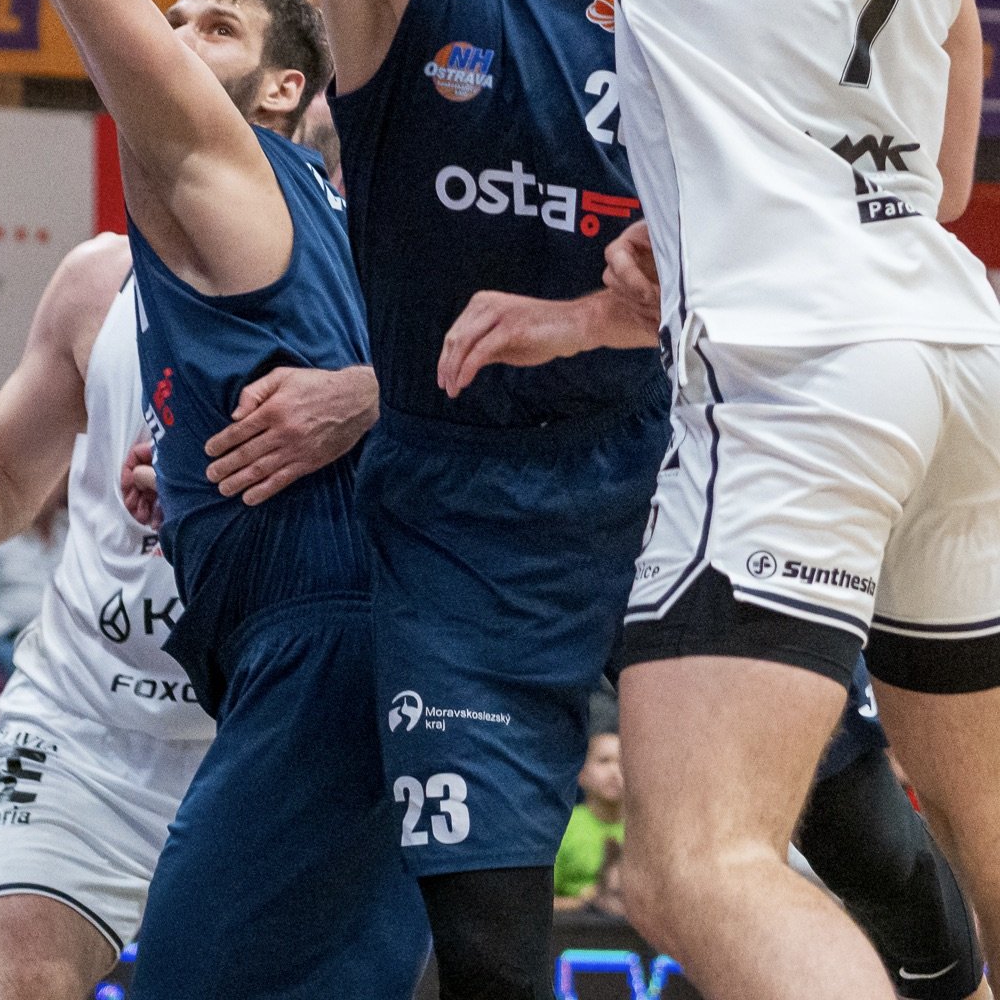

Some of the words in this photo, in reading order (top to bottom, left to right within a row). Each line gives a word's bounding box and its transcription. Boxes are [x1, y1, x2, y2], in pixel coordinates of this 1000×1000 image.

[448, 45, 495, 75] NH
[584, 69, 627, 147] 2
[782, 560, 876, 597] Synthesia
[110, 673, 199, 704] FOXC
[425, 706, 511, 726] Moravskoslezský
[425, 718, 446, 732] kraj
[393, 772, 470, 847] 23
